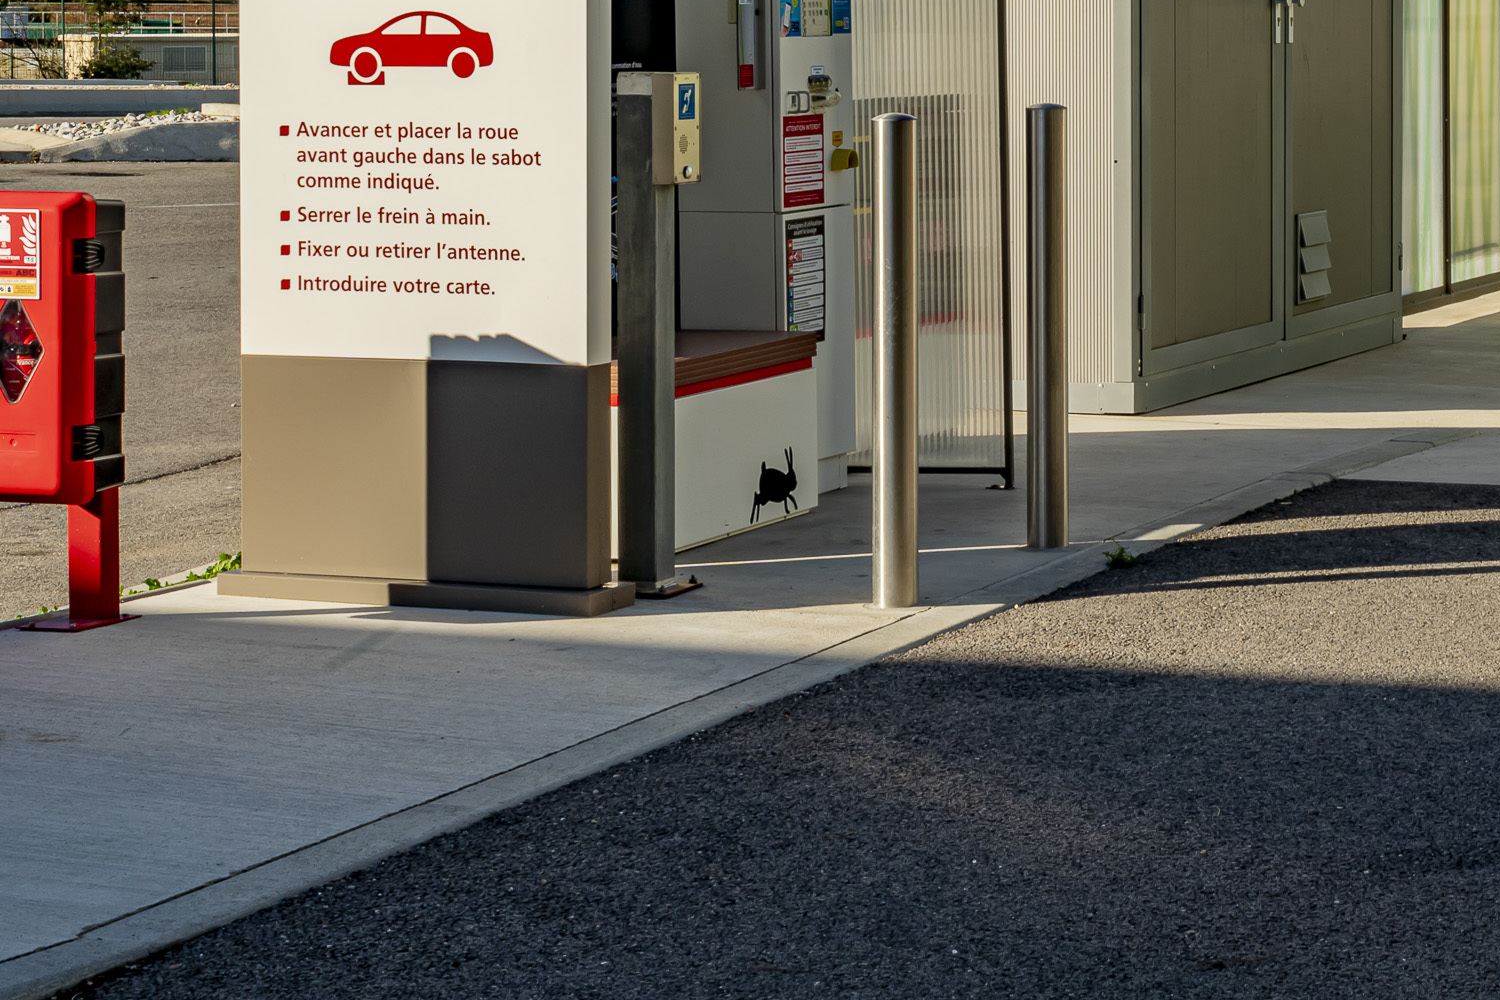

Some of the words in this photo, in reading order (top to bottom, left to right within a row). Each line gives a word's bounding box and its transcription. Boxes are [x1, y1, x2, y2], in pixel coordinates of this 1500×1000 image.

[297, 122, 368, 137] Avancer
[375, 124, 392, 138] et
[398, 122, 451, 142] placer
[458, 122, 471, 139] la
[479, 128, 518, 139] roue
[297, 149, 347, 163] avant
[353, 147, 416, 167] gauche
[423, 148, 464, 164] dans
[472, 148, 485, 165] le
[492, 149, 541, 166] sabot
[297, 176, 361, 188] comme
[368, 173, 439, 193] indiqué.
[298, 207, 350, 222] Serrer
[357, 207, 371, 223] le
[378, 207, 418, 224] frein
[426, 208, 435, 224] à
[442, 209, 490, 225] main.
[299, 240, 340, 257] Fixer
[347, 246, 368, 257] ou
[376, 242, 431, 258] retirer
[437, 243, 525, 261] l'antenne.
[299, 275, 387, 292] Introduire
[393, 279, 440, 293] votre
[447, 280, 495, 295] carte.
